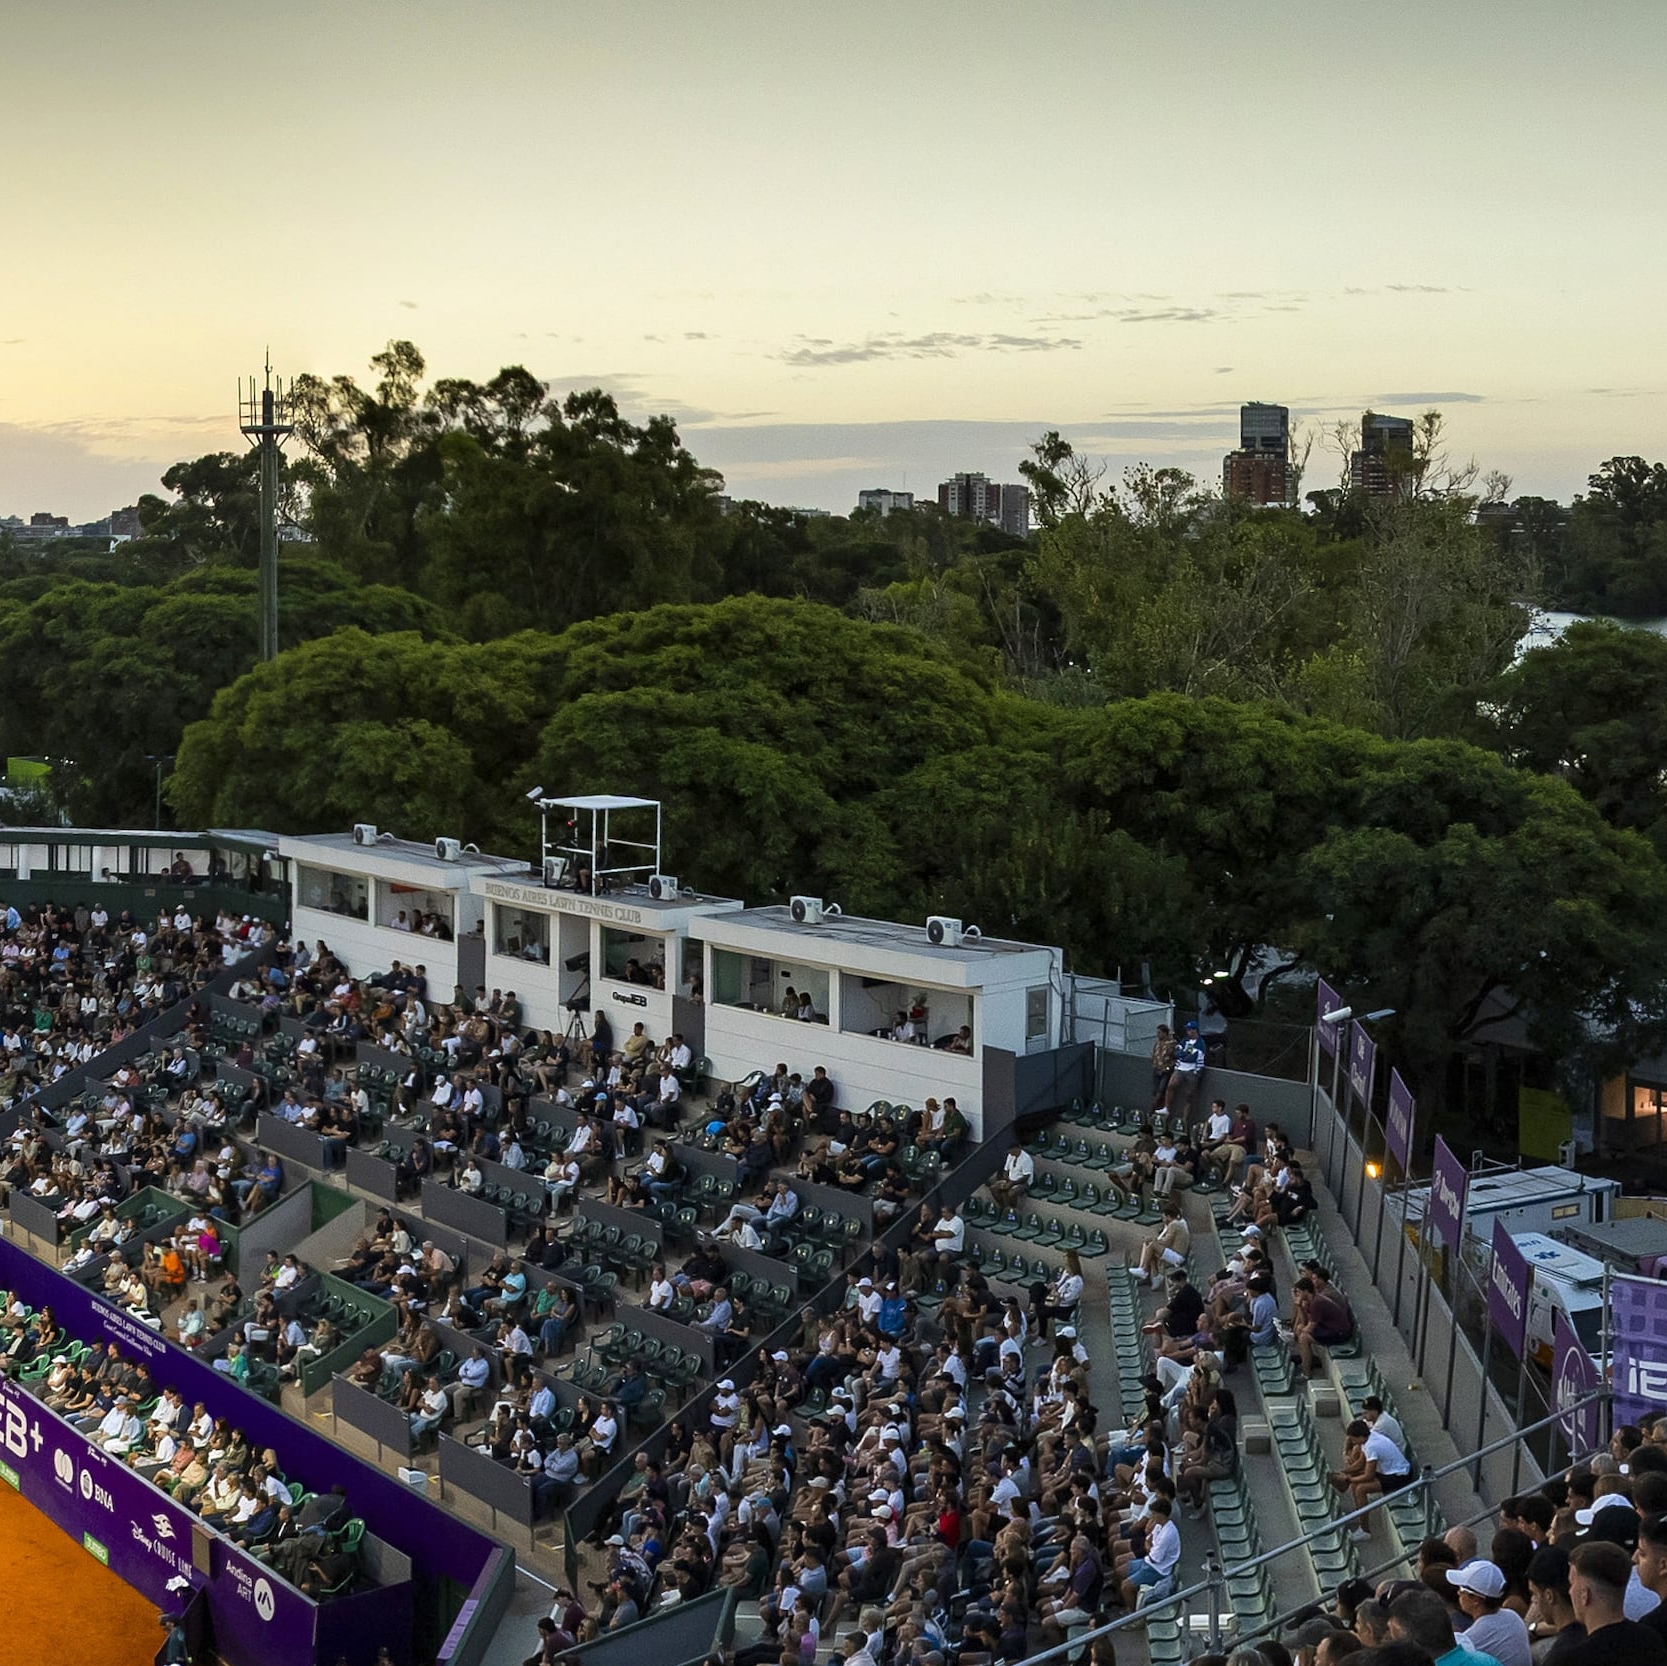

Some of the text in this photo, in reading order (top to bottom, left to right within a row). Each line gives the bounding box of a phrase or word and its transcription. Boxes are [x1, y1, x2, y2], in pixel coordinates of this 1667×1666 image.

[485, 882, 642, 924] BUENOS AIRES LAWN TENNIS CLUB
[94, 1484, 115, 1513] BNA
[225, 1560, 253, 1587] Andina
[237, 1583, 253, 1602] ART
